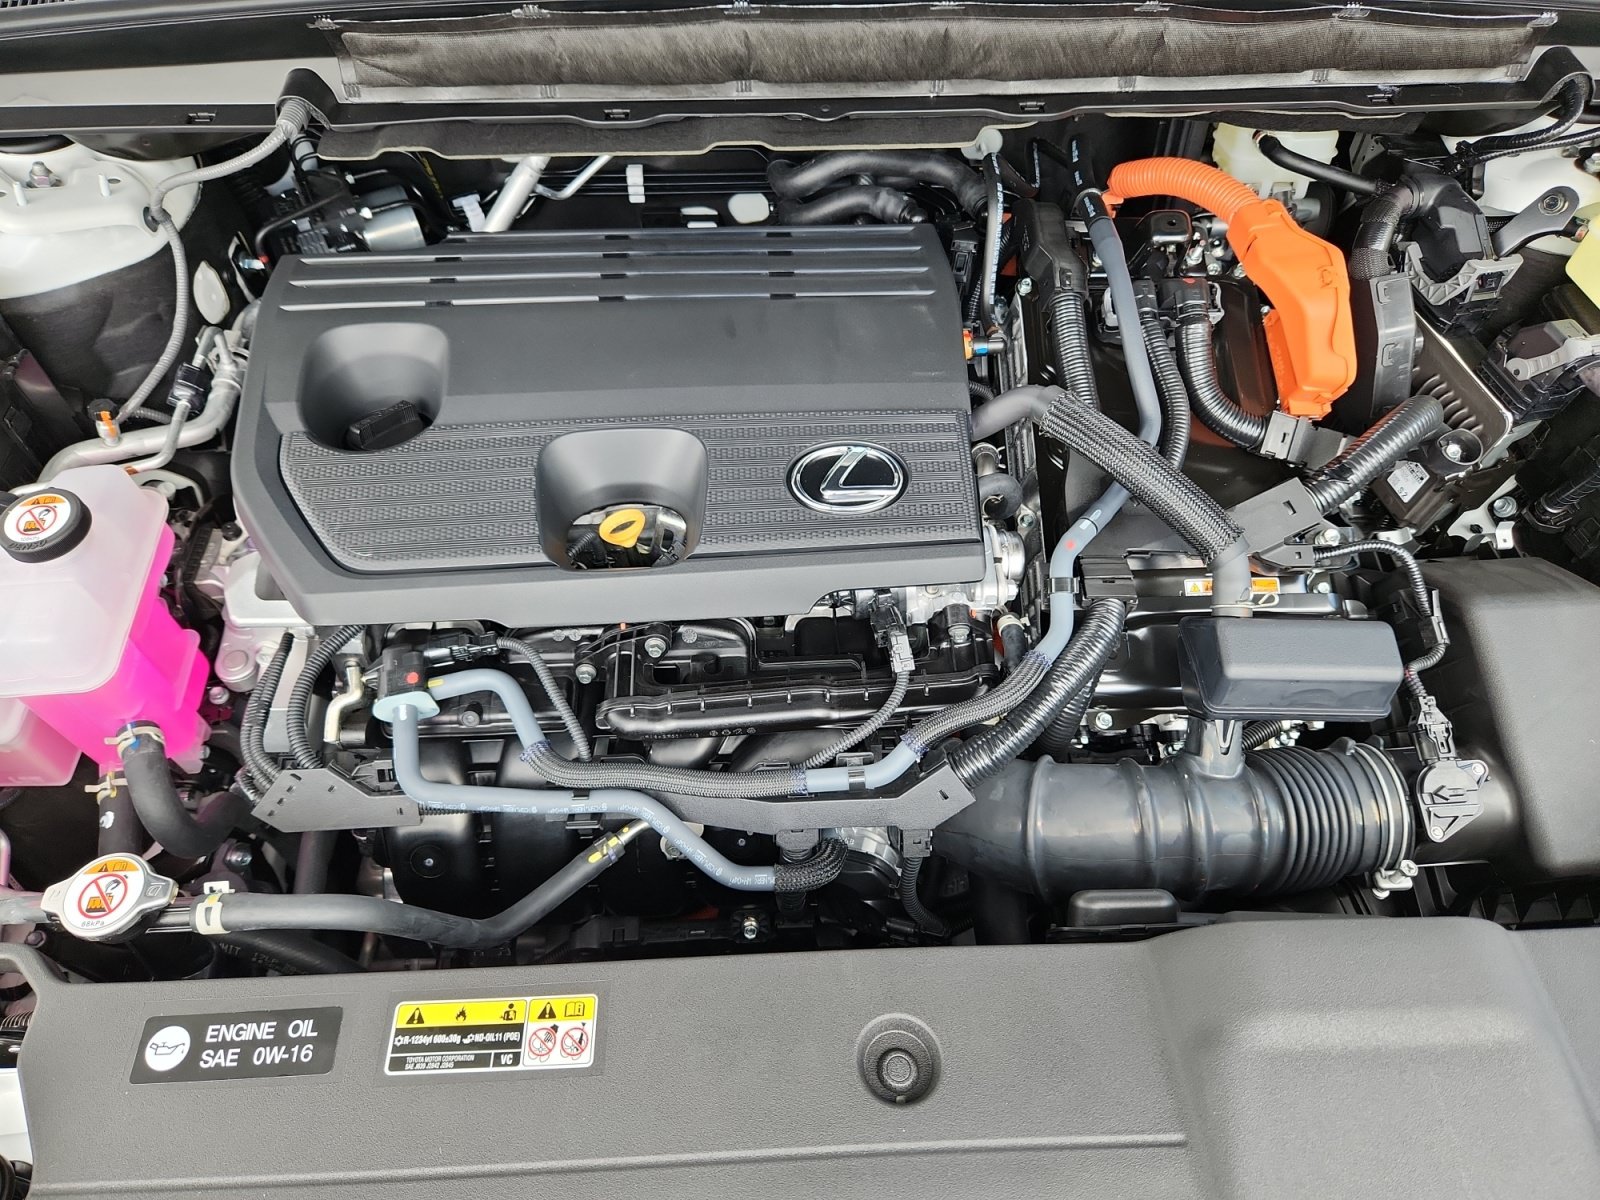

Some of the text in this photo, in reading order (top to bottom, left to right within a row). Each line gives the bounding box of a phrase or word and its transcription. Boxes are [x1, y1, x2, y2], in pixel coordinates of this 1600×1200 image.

[7, 539, 48, 551] DENSO
[205, 1019, 318, 1043] ENGINE OIL
[503, 1031, 520, 1043] (POE)
[199, 1044, 314, 1069] SAE 0W-16
[442, 1054, 475, 1062] CORPORATION
[500, 1053, 513, 1065] VC
